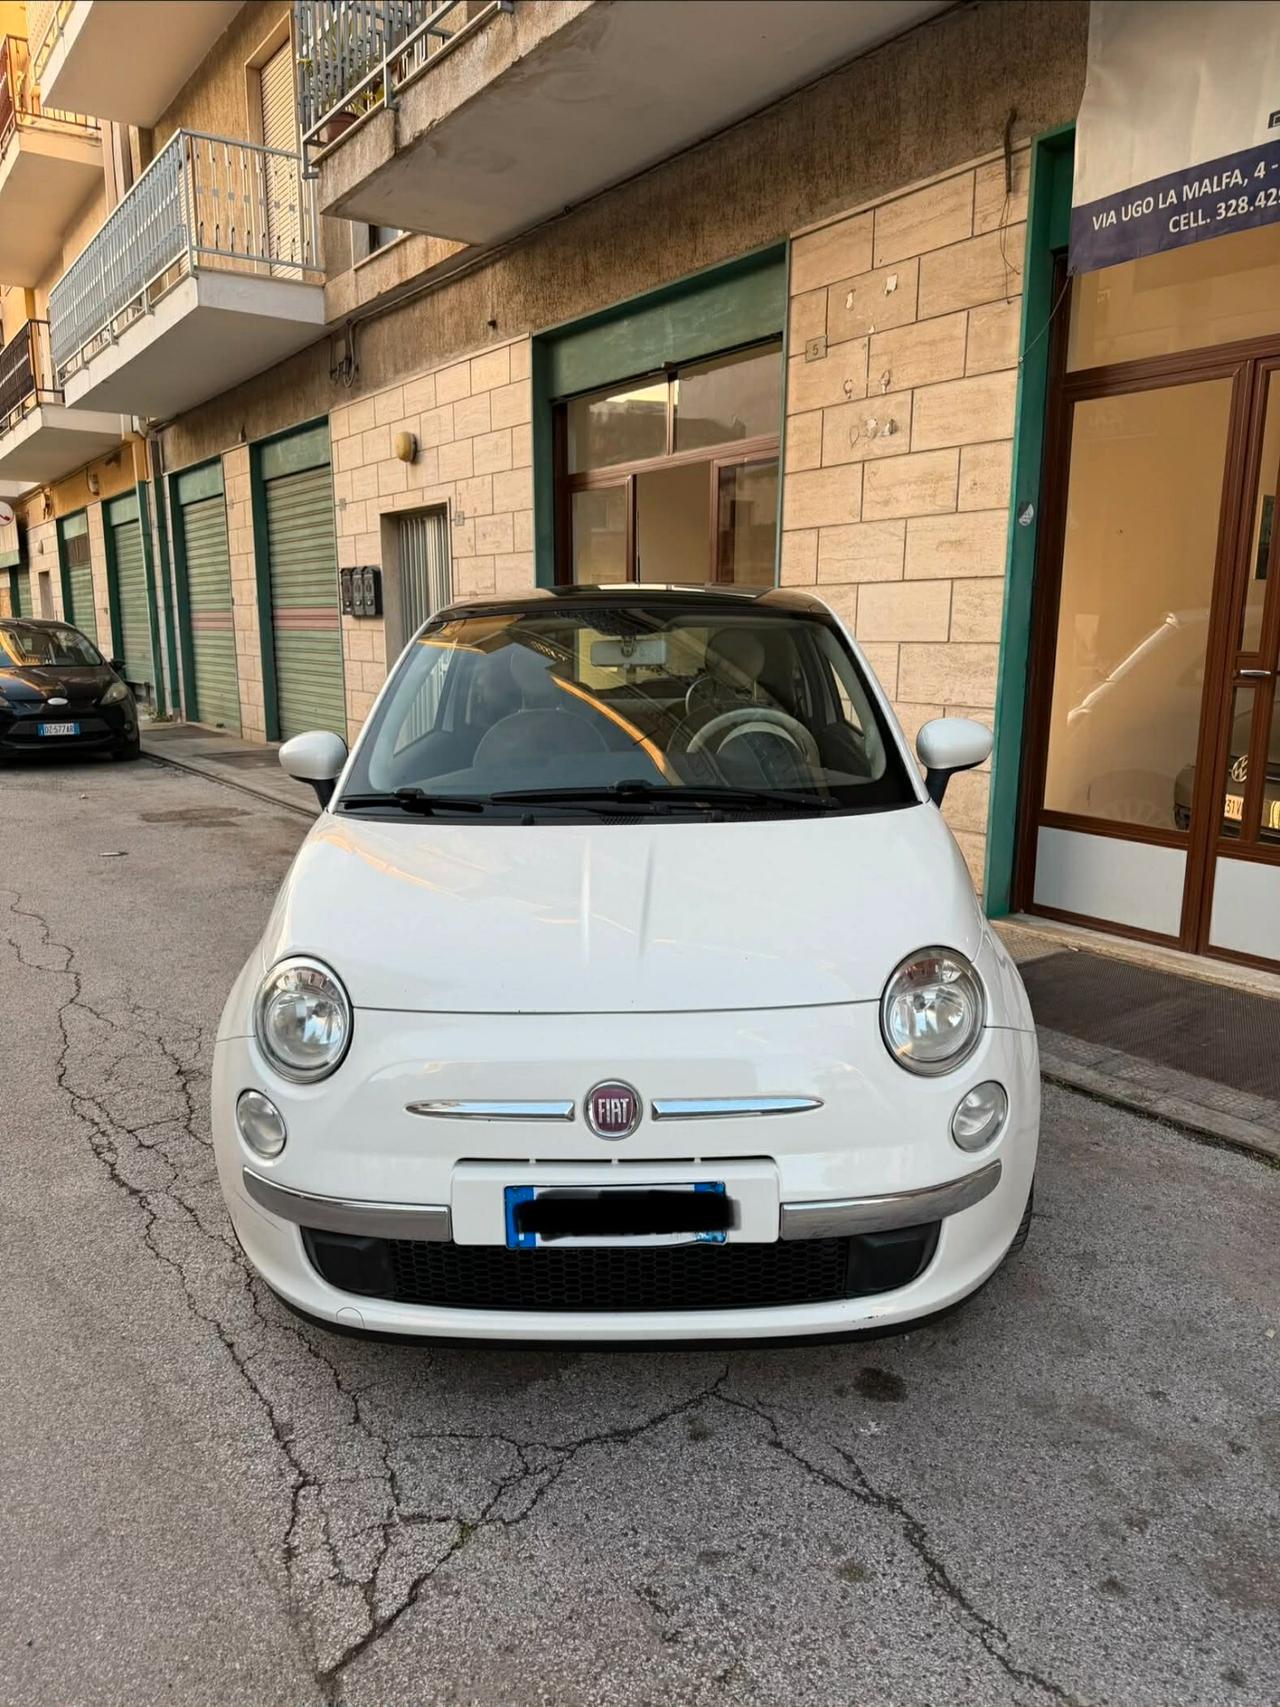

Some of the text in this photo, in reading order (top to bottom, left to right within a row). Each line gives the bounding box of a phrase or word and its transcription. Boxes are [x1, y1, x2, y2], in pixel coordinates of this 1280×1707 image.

[1092, 211, 1117, 231] VIA
[1121, 197, 1154, 222] UGO
[1158, 189, 1178, 209] LA
[1183, 169, 1249, 202] MALFA,
[1254, 161, 1266, 179] 4
[1169, 211, 1211, 233] CELL.
[812, 343, 819, 356] 5
[598, 1098, 630, 1124] FIAT
